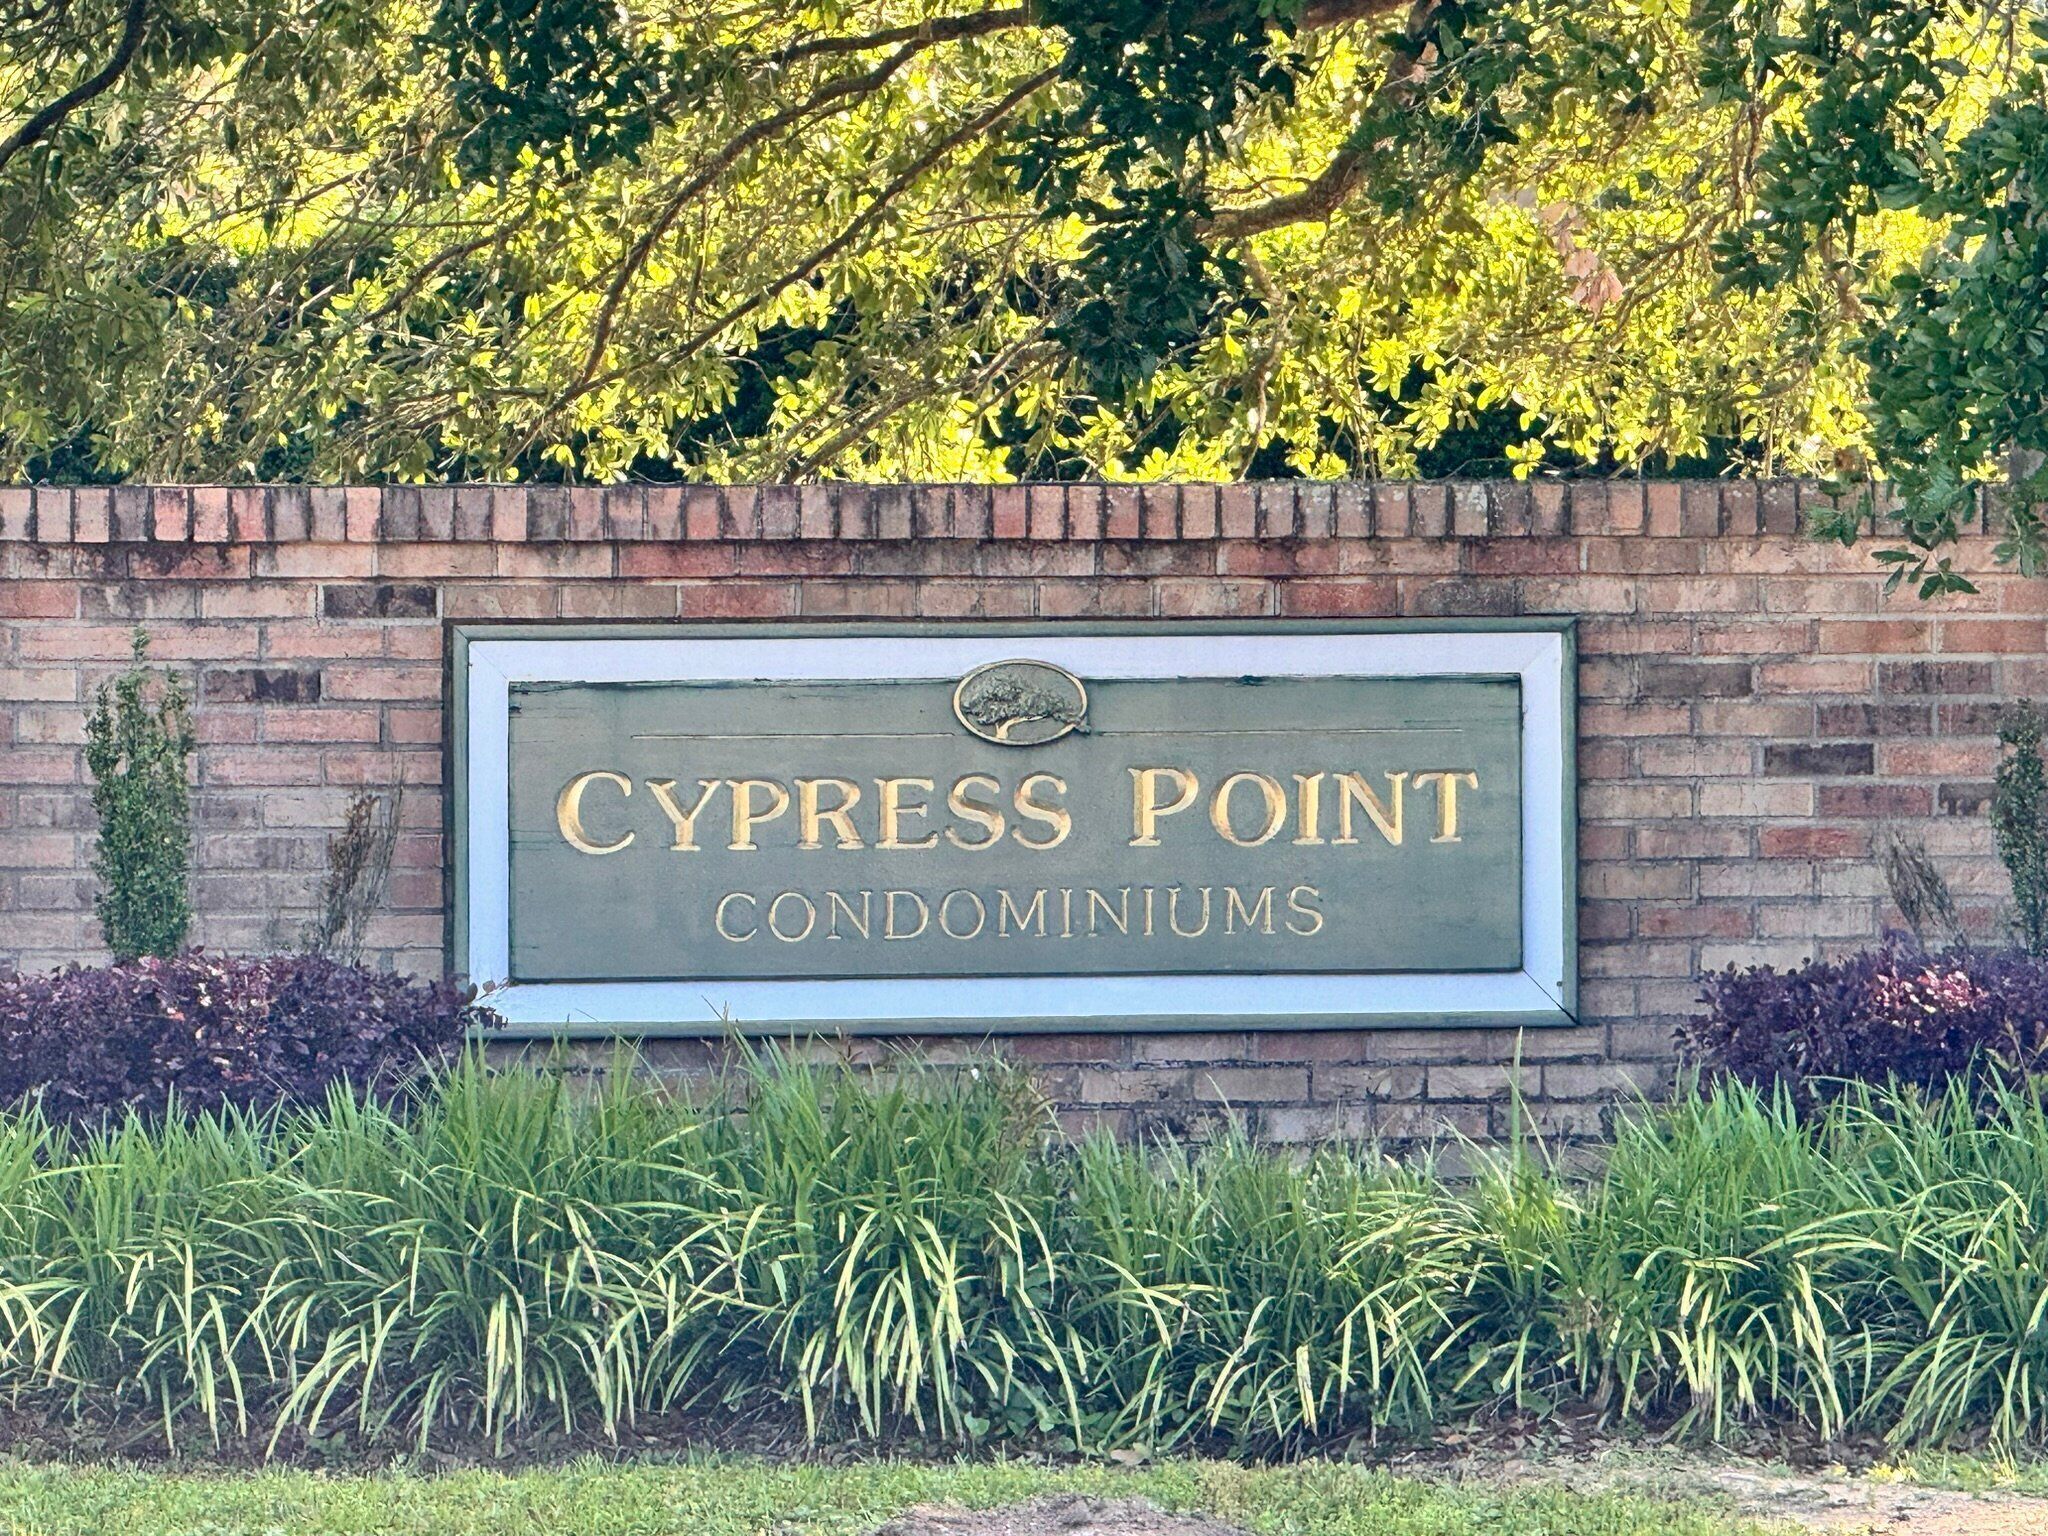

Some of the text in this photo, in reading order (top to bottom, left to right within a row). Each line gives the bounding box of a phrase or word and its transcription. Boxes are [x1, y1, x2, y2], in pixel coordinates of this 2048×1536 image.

[556, 766, 1480, 856] CYPRESS POINT
[714, 885, 1326, 944] CONDOMINIUMS
